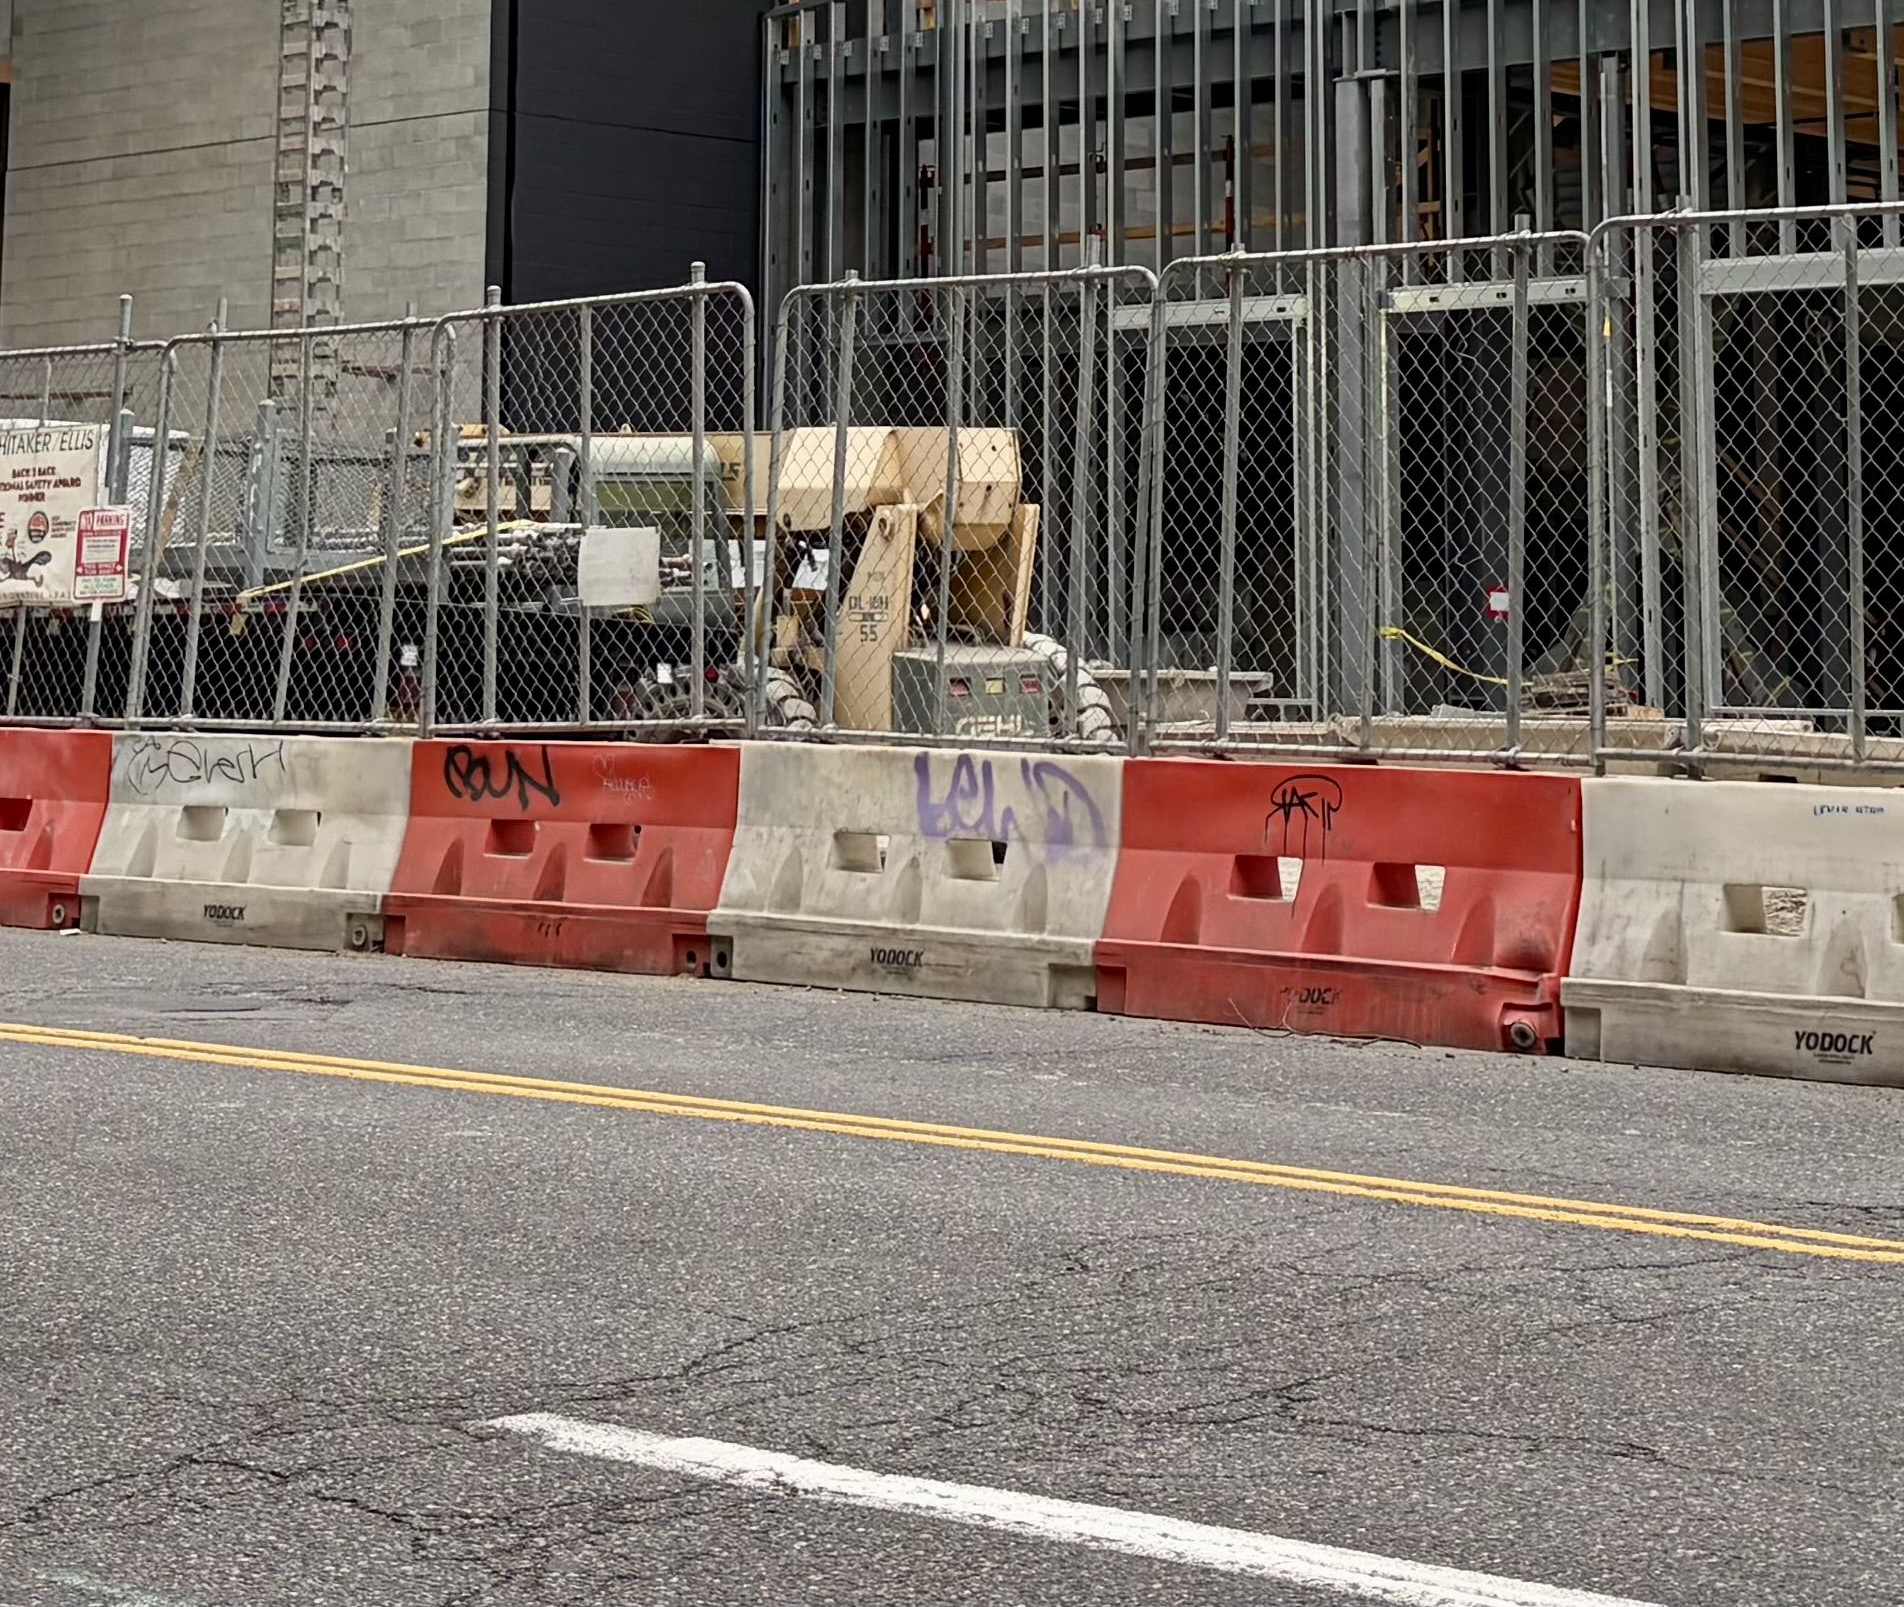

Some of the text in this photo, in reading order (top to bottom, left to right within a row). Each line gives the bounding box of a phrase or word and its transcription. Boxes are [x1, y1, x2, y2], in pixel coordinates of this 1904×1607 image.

[12, 468, 30, 479] BACK
[38, 466, 57, 476] BACK
[860, 624, 878, 642] 55
[203, 904, 247, 921] YODOCK
[870, 947, 925, 968] YODOCK
[1794, 1030, 1874, 1055] YODOCK
